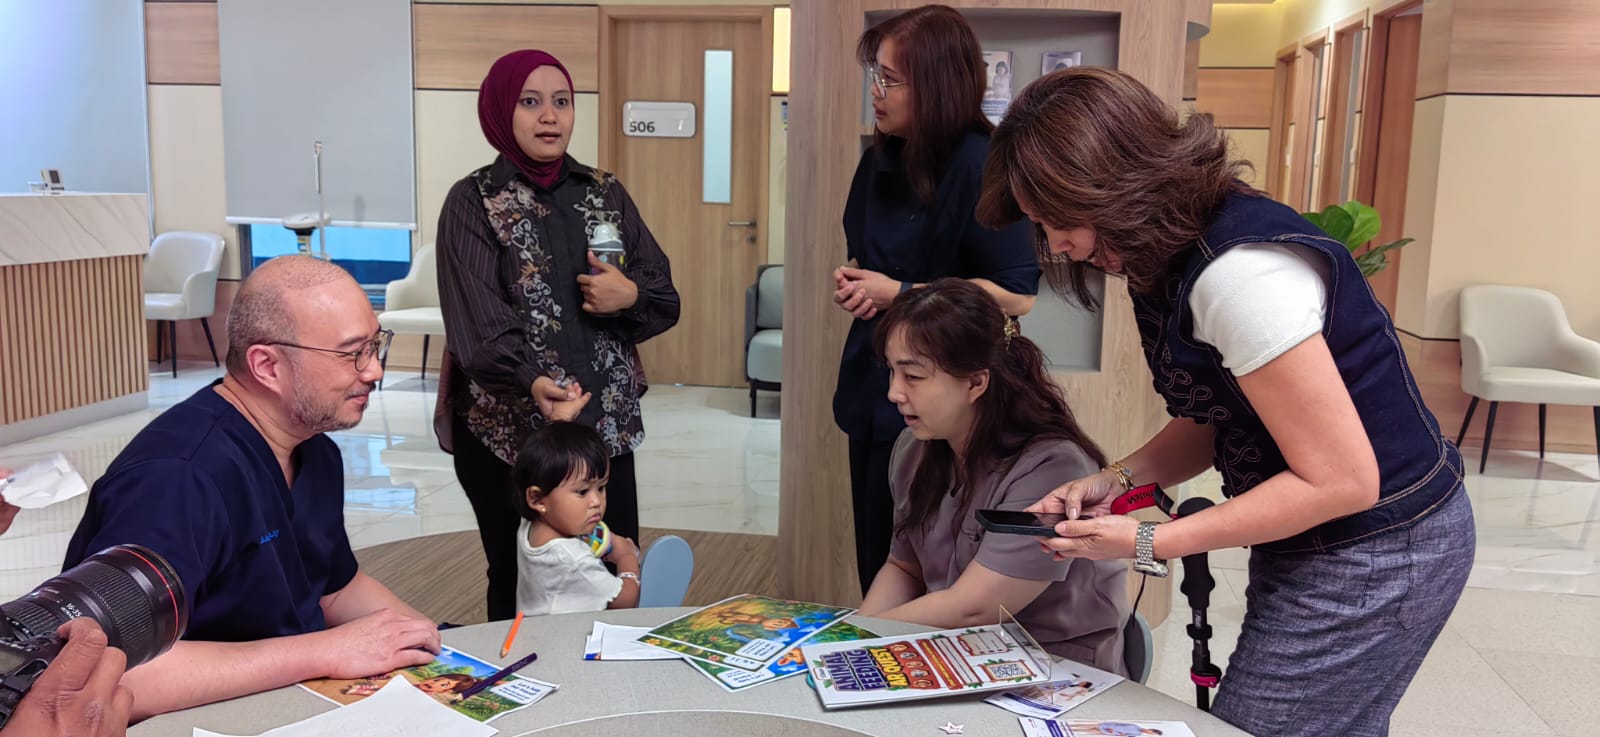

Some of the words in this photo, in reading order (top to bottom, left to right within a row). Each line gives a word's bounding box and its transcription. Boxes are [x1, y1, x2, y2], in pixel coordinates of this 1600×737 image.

[629, 120, 656, 133] 506
[821, 651, 863, 691] ANIMAL
[845, 648, 890, 691] FEEDING
[869, 647, 902, 674] QUEST
[886, 673, 909, 687] AR
